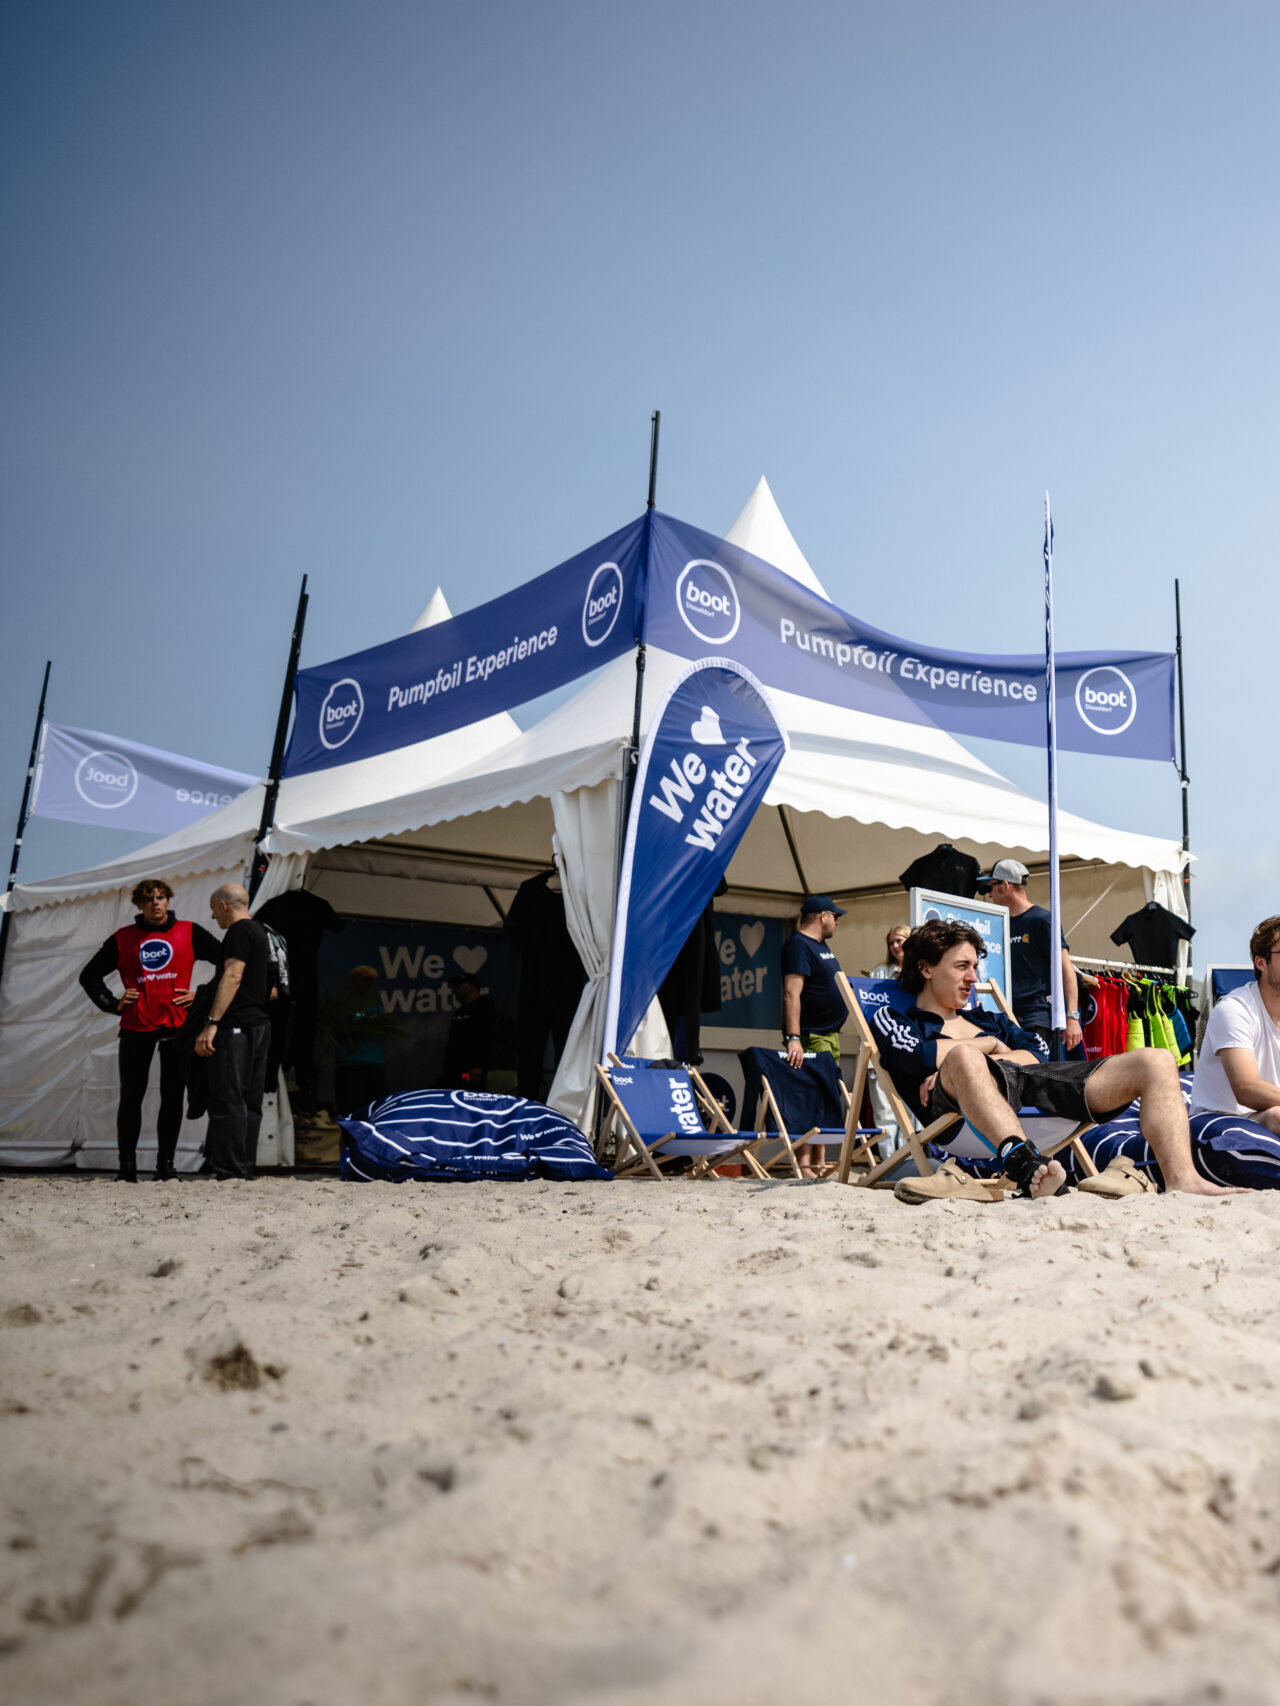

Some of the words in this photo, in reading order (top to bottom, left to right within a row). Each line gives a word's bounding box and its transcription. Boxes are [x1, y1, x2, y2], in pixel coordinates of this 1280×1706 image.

[589, 585, 617, 617] boot
[686, 580, 730, 616] boot
[387, 661, 463, 712] Pumpfoil
[465, 625, 558, 683] Experience
[780, 618, 898, 674] Pumpfoil
[900, 656, 1038, 702] Experience
[327, 699, 358, 722] boot
[1085, 686, 1128, 708] boot
[649, 752, 707, 824] We
[684, 736, 758, 852] water
[142, 947, 168, 959] boot
[378, 945, 446, 980] We
[379, 982, 490, 1014] wat
[720, 966, 768, 1003] ater
[859, 988, 890, 1003] boot
[613, 1075, 634, 1084] boot
[543, 1126, 568, 1135] water
